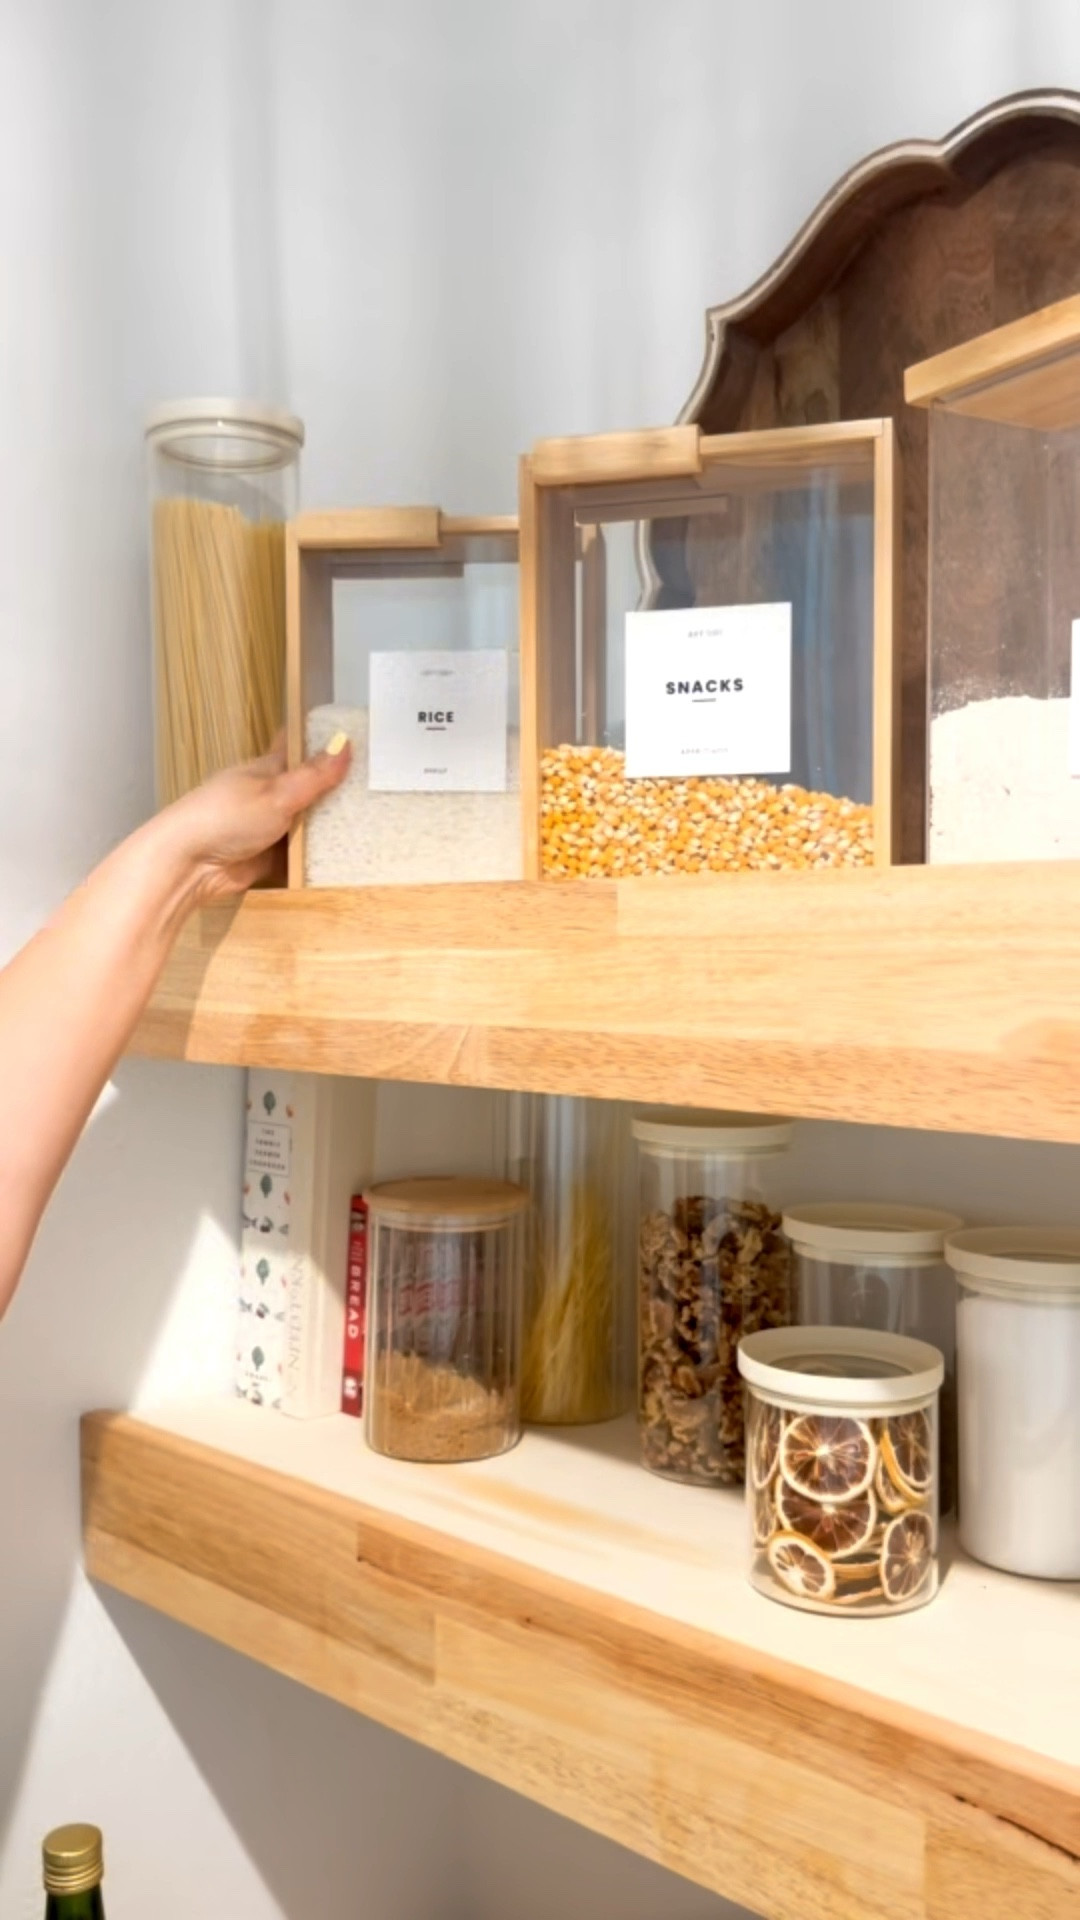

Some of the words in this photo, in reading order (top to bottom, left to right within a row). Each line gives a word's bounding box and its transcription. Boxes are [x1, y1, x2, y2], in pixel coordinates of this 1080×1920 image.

[666, 678, 744, 695] SNACKS
[418, 711, 455, 723] RICE
[347, 1264, 361, 1339] BREAD
